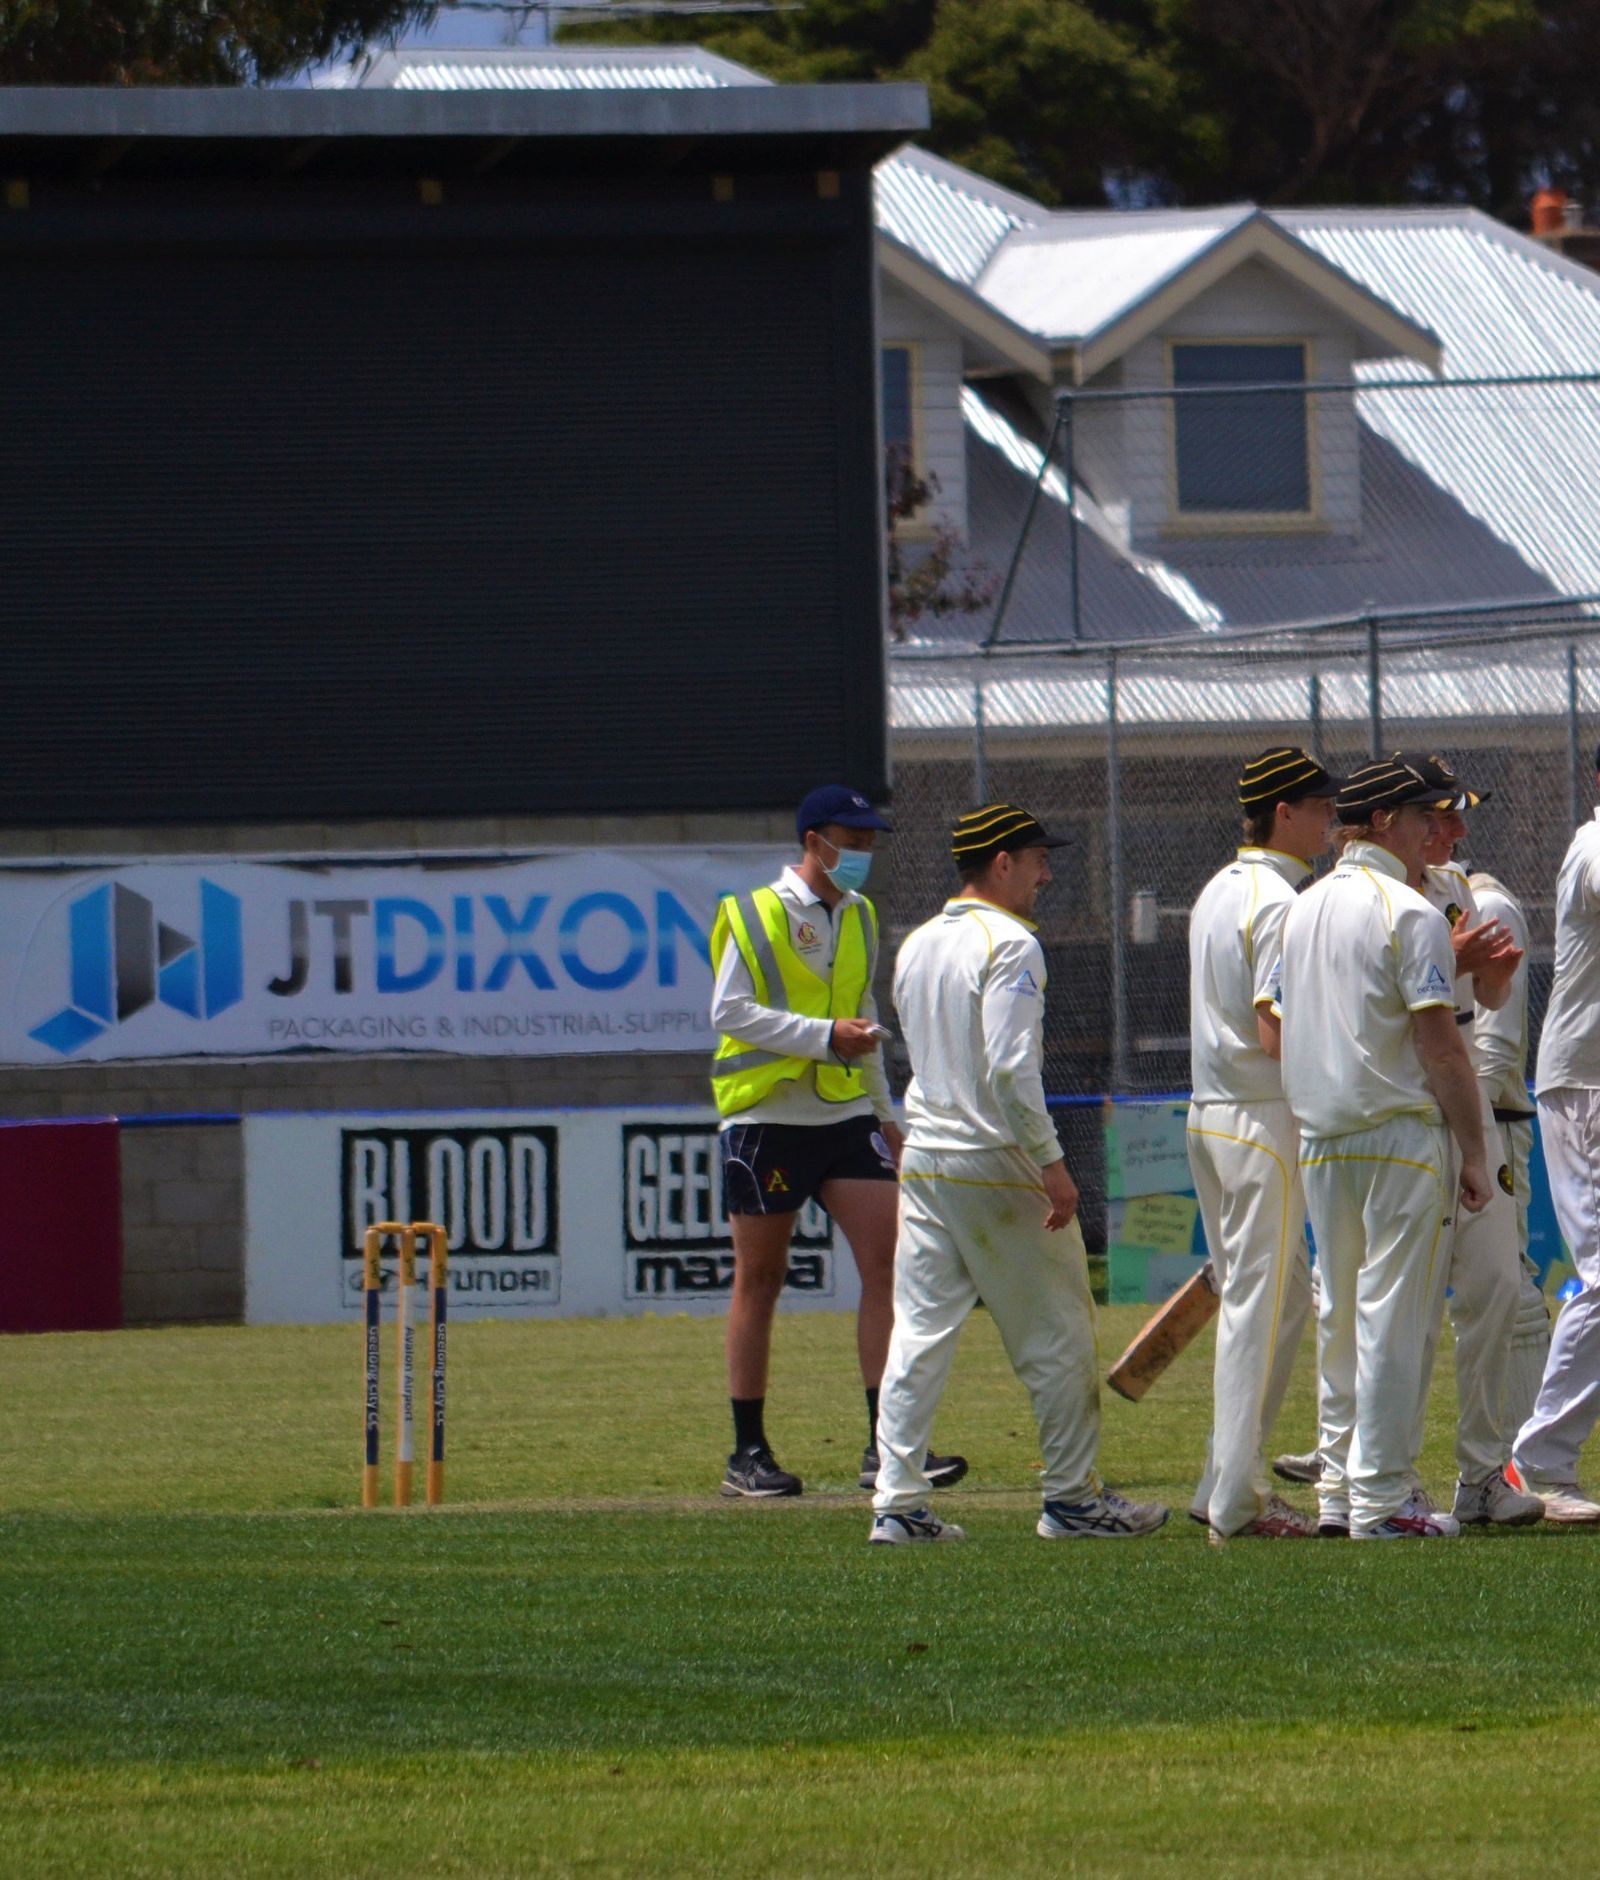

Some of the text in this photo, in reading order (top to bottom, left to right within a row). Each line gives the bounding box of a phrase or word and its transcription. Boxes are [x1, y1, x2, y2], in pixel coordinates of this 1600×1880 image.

[269, 1015, 427, 1041] PACKAGING
[436, 1014, 456, 1039] &
[464, 1012, 617, 1037] INDUSTRIAL
[350, 1134, 548, 1252] BLOOD
[628, 1134, 829, 1241] GEEL
[403, 1326, 415, 1421] Avalon Airport
